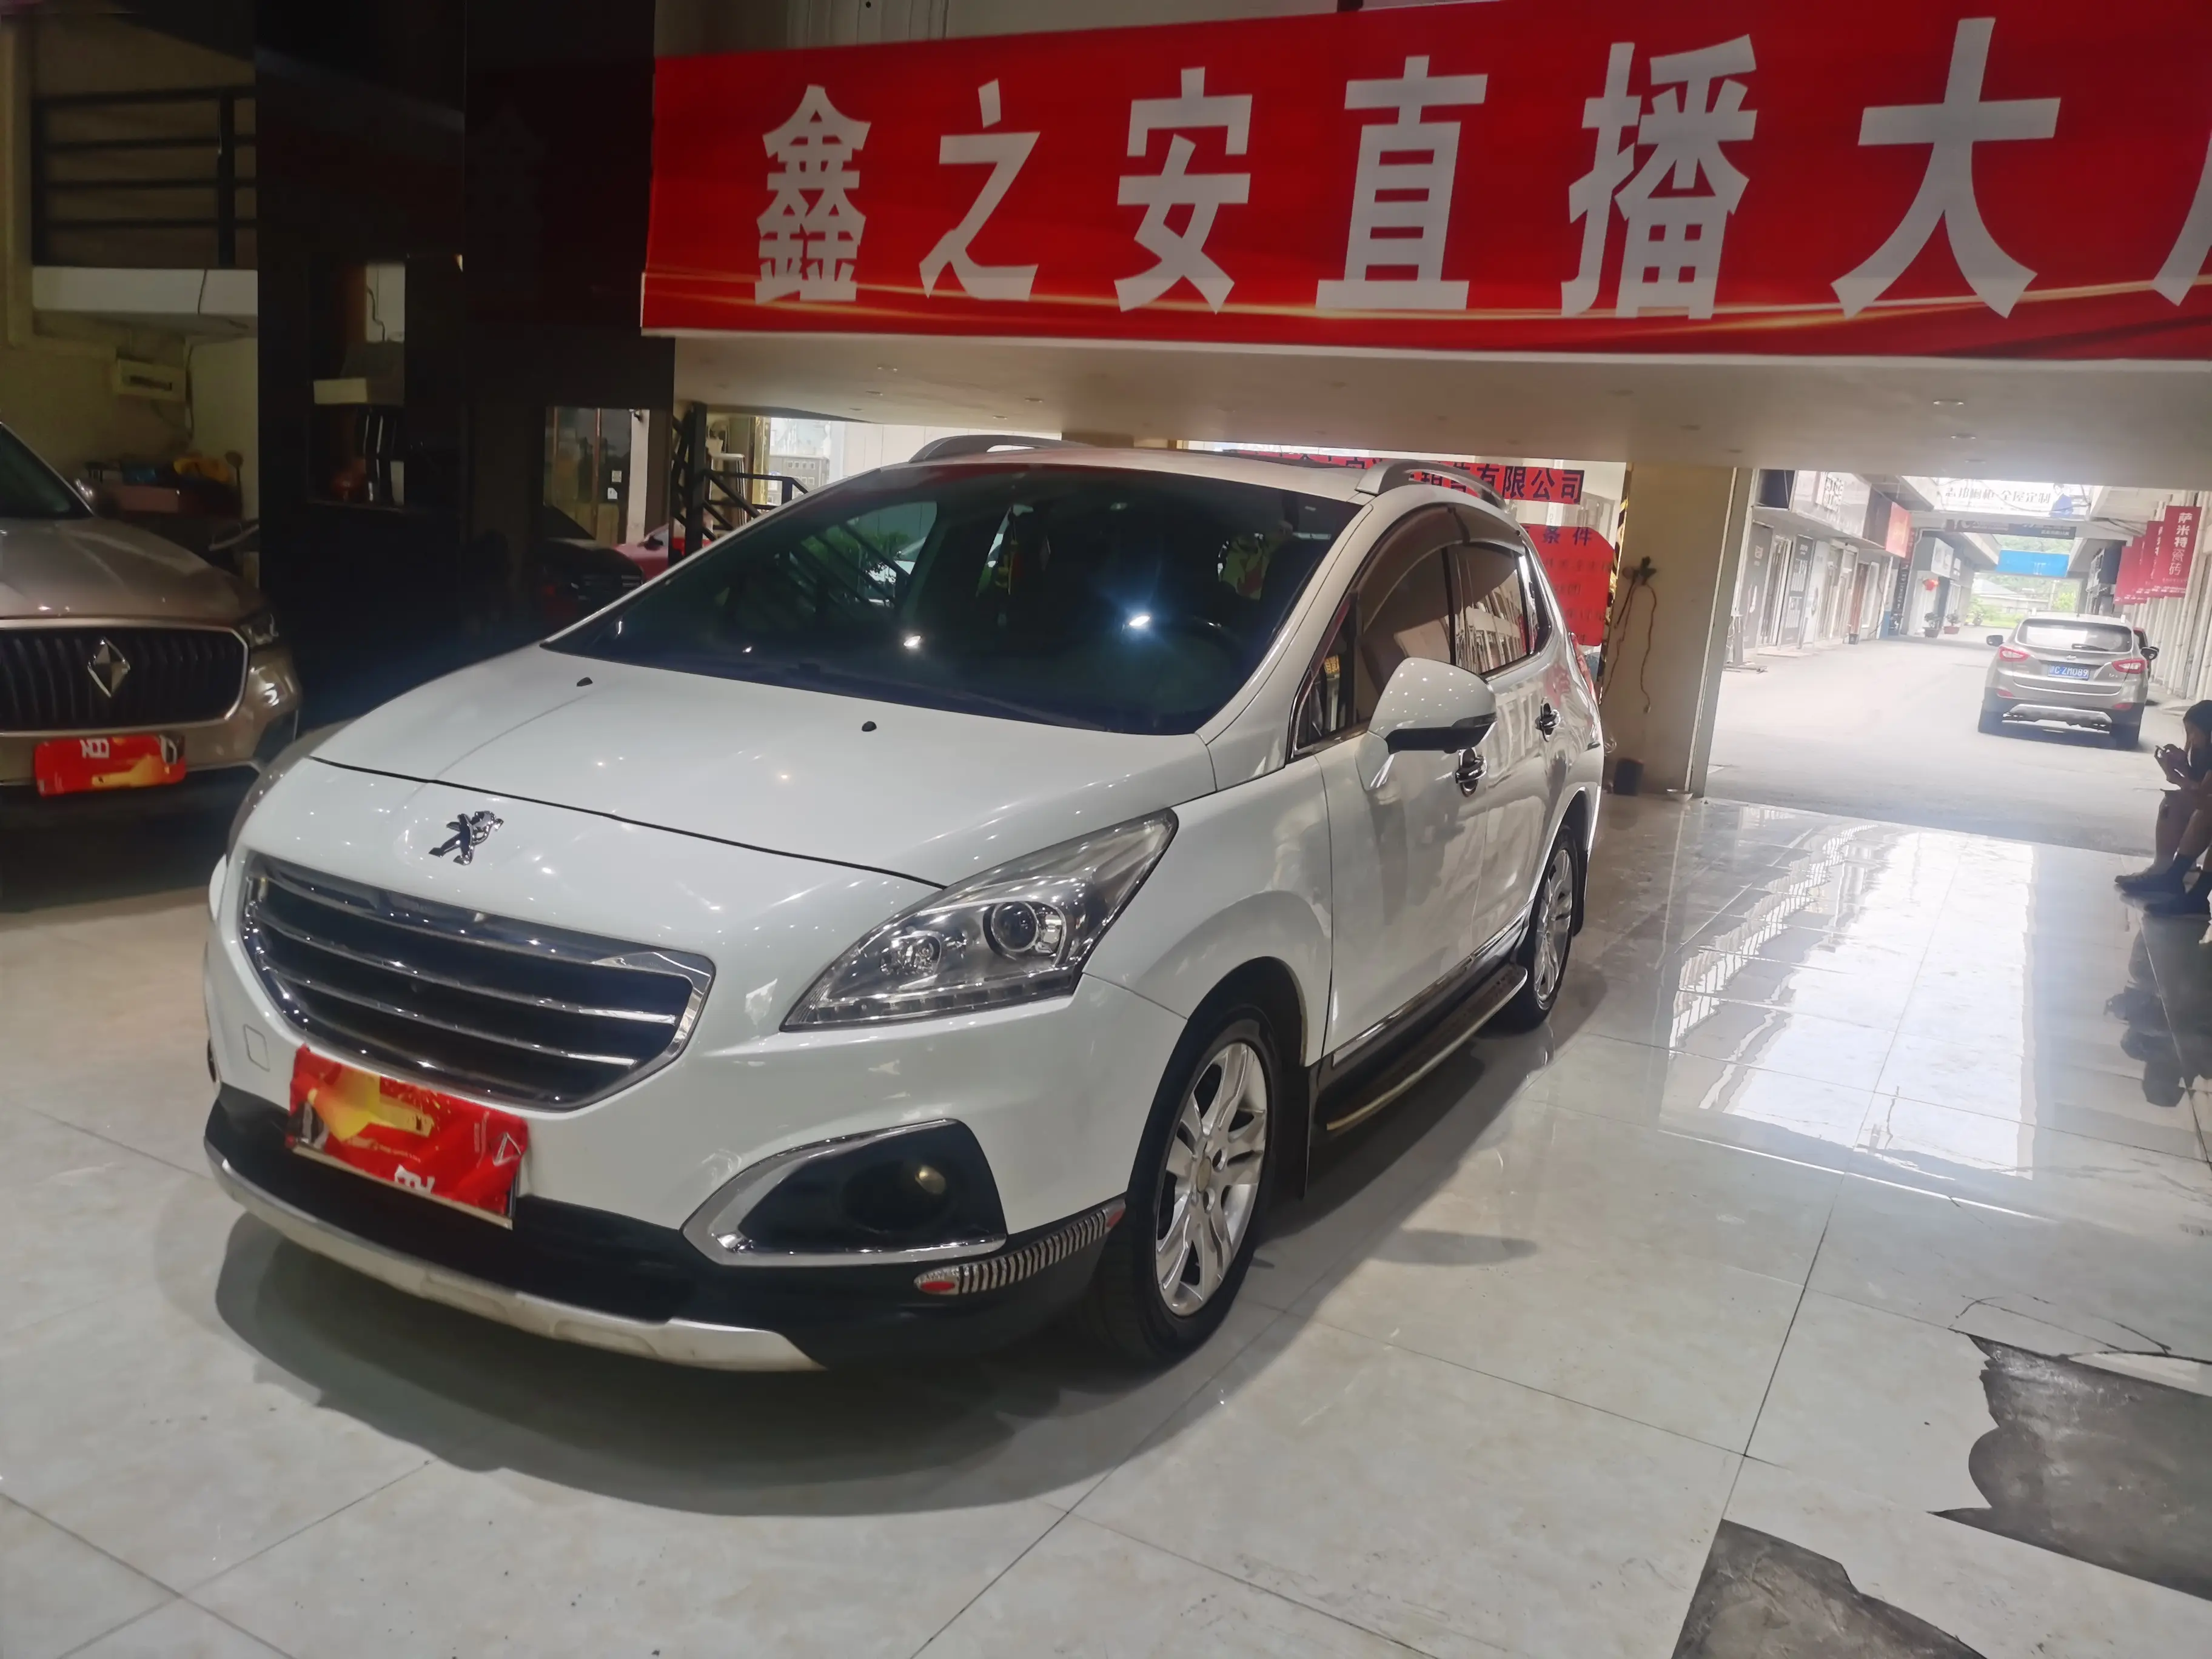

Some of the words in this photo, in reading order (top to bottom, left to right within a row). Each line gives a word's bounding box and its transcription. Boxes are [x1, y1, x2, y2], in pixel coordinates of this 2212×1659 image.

[2168, 512, 2193, 575] 萨米特瓷砖
